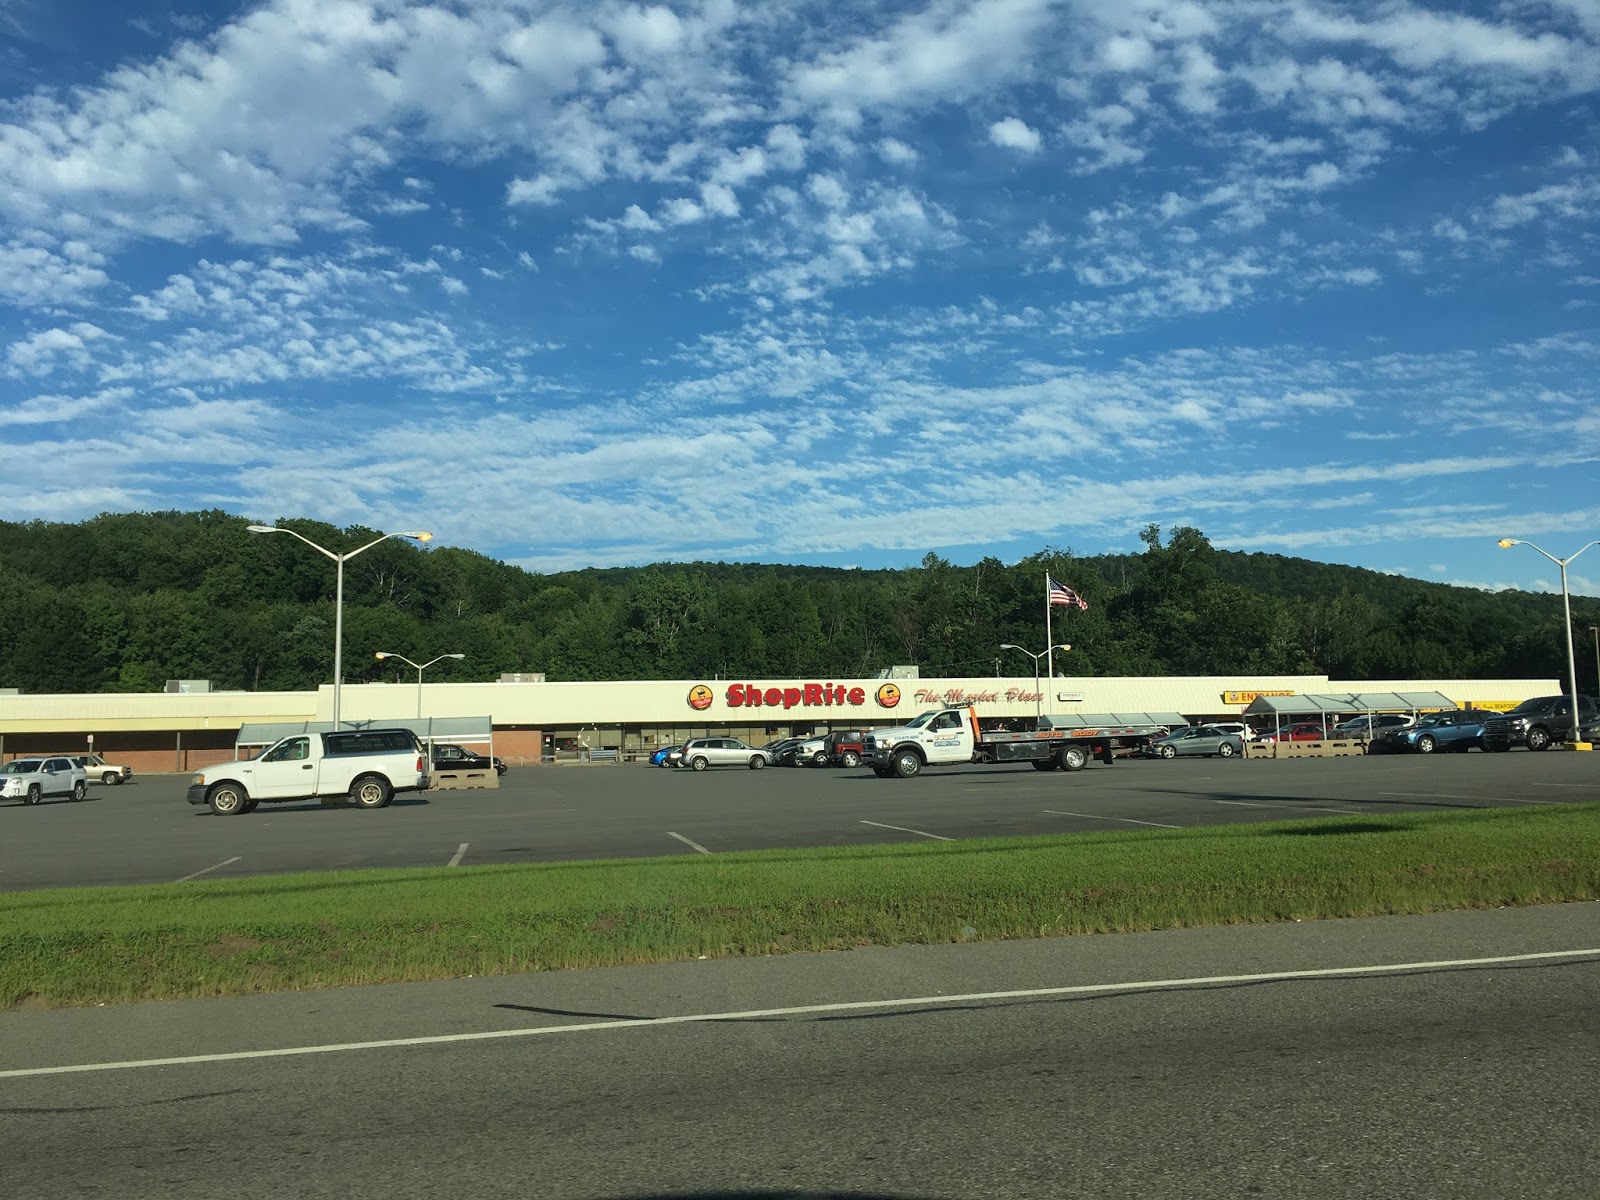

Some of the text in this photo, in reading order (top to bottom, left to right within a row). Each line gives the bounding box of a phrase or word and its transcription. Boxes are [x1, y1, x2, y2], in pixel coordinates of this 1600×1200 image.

[727, 683, 865, 709] ShopRite
[915, 689, 940, 703] The
[945, 688, 999, 702] Market
[1006, 688, 1044, 701] Place
